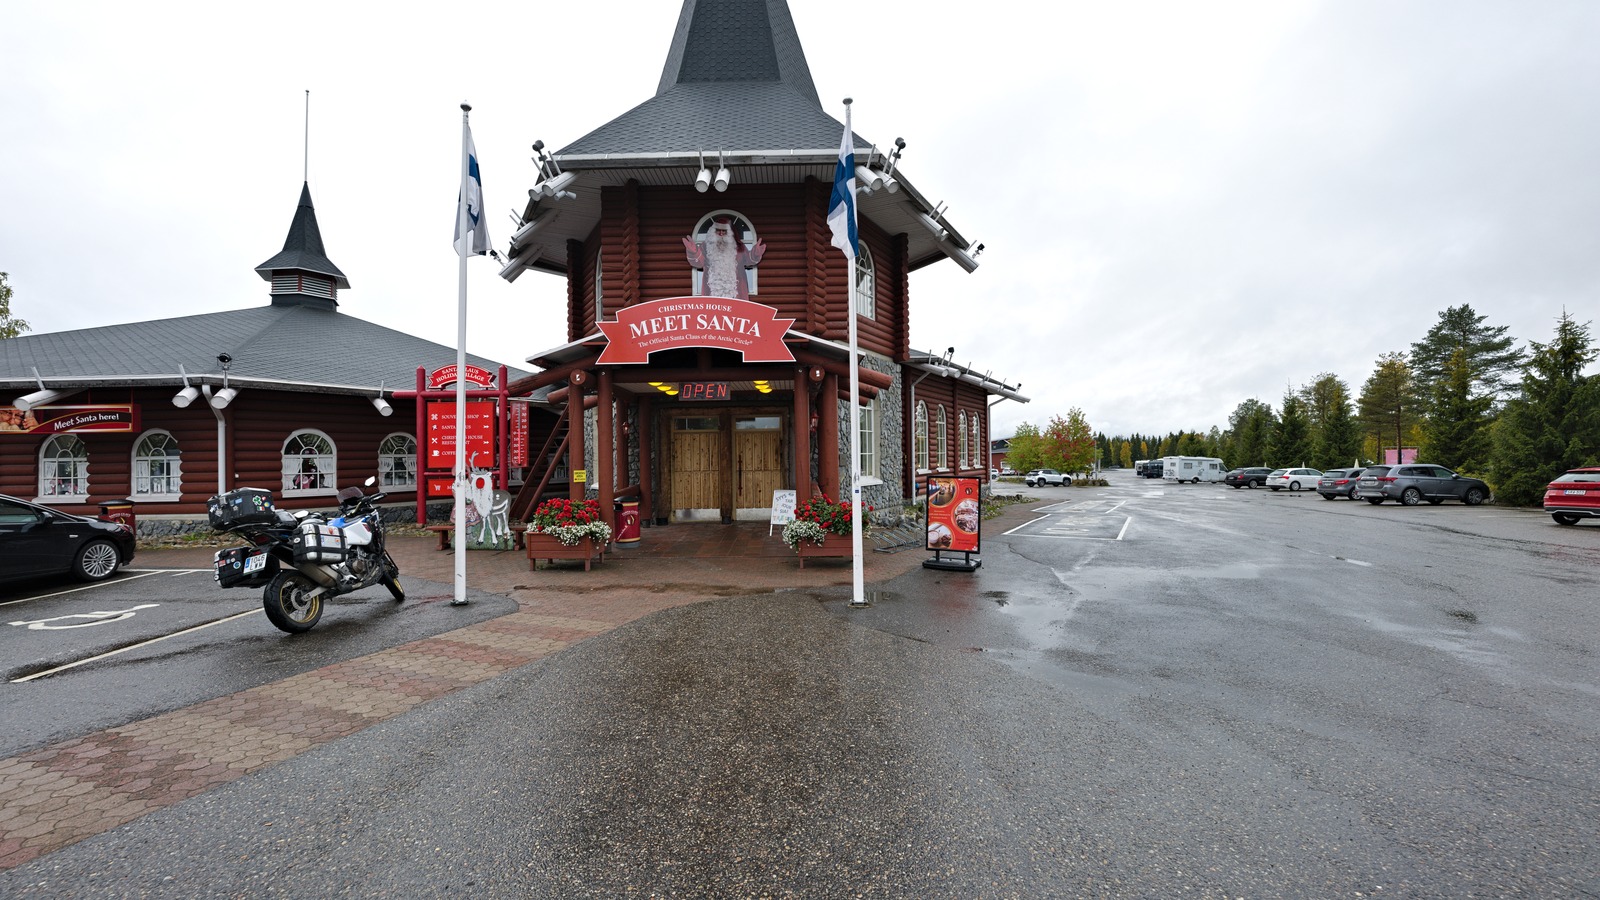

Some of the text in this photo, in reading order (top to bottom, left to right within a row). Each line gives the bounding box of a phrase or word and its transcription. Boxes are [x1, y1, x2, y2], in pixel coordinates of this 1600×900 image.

[658, 303, 732, 313] CHRISTMAS HOUSE
[629, 313, 762, 340] MEET SANTA
[649, 336, 670, 345] Official
[716, 335, 734, 344] Arctic
[442, 366, 459, 374] SANT
[436, 372, 485, 382] HOLIDA ILLAGE
[682, 384, 726, 398] OPEN
[54, 418, 75, 431] Meet
[75, 414, 98, 424] Santa
